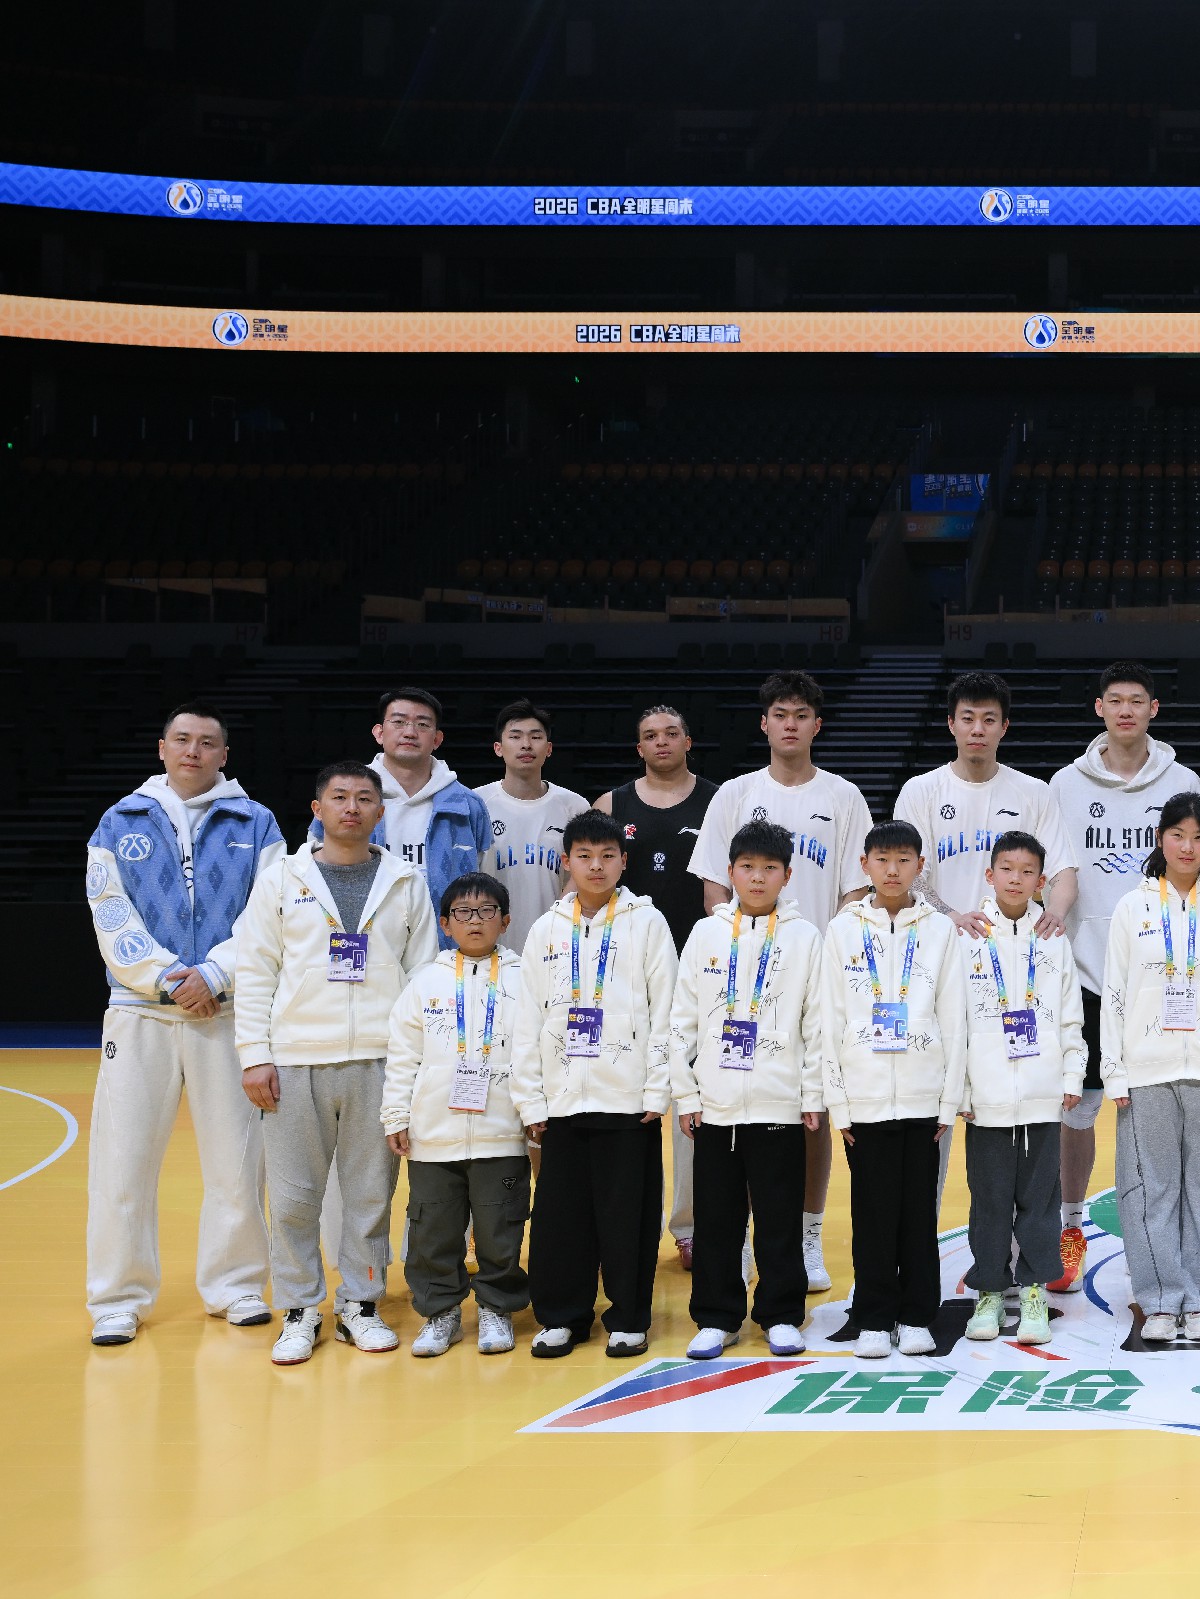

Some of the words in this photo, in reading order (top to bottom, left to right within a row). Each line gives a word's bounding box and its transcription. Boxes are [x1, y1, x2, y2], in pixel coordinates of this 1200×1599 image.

[534, 197, 578, 215] 2026
[587, 197, 693, 215] CBA全明星周末
[1017, 200, 1050, 209] 全明星
[253, 324, 288, 333] 全明星
[576, 325, 621, 343] 2026
[630, 324, 740, 343] CBA全明星周末
[1062, 326, 1095, 334] 全明星
[236, 625, 258, 641] H7
[364, 625, 388, 641] H8
[820, 625, 843, 641] H8
[950, 624, 973, 641] H9
[1085, 824, 1116, 849] ALL
[1122, 823, 1156, 849] STA
[402, 842, 425, 864] ST
[937, 831, 969, 864] ALL
[975, 828, 1002, 852] ST
[496, 845, 518, 871] LL
[894, 1019, 907, 1038] C
